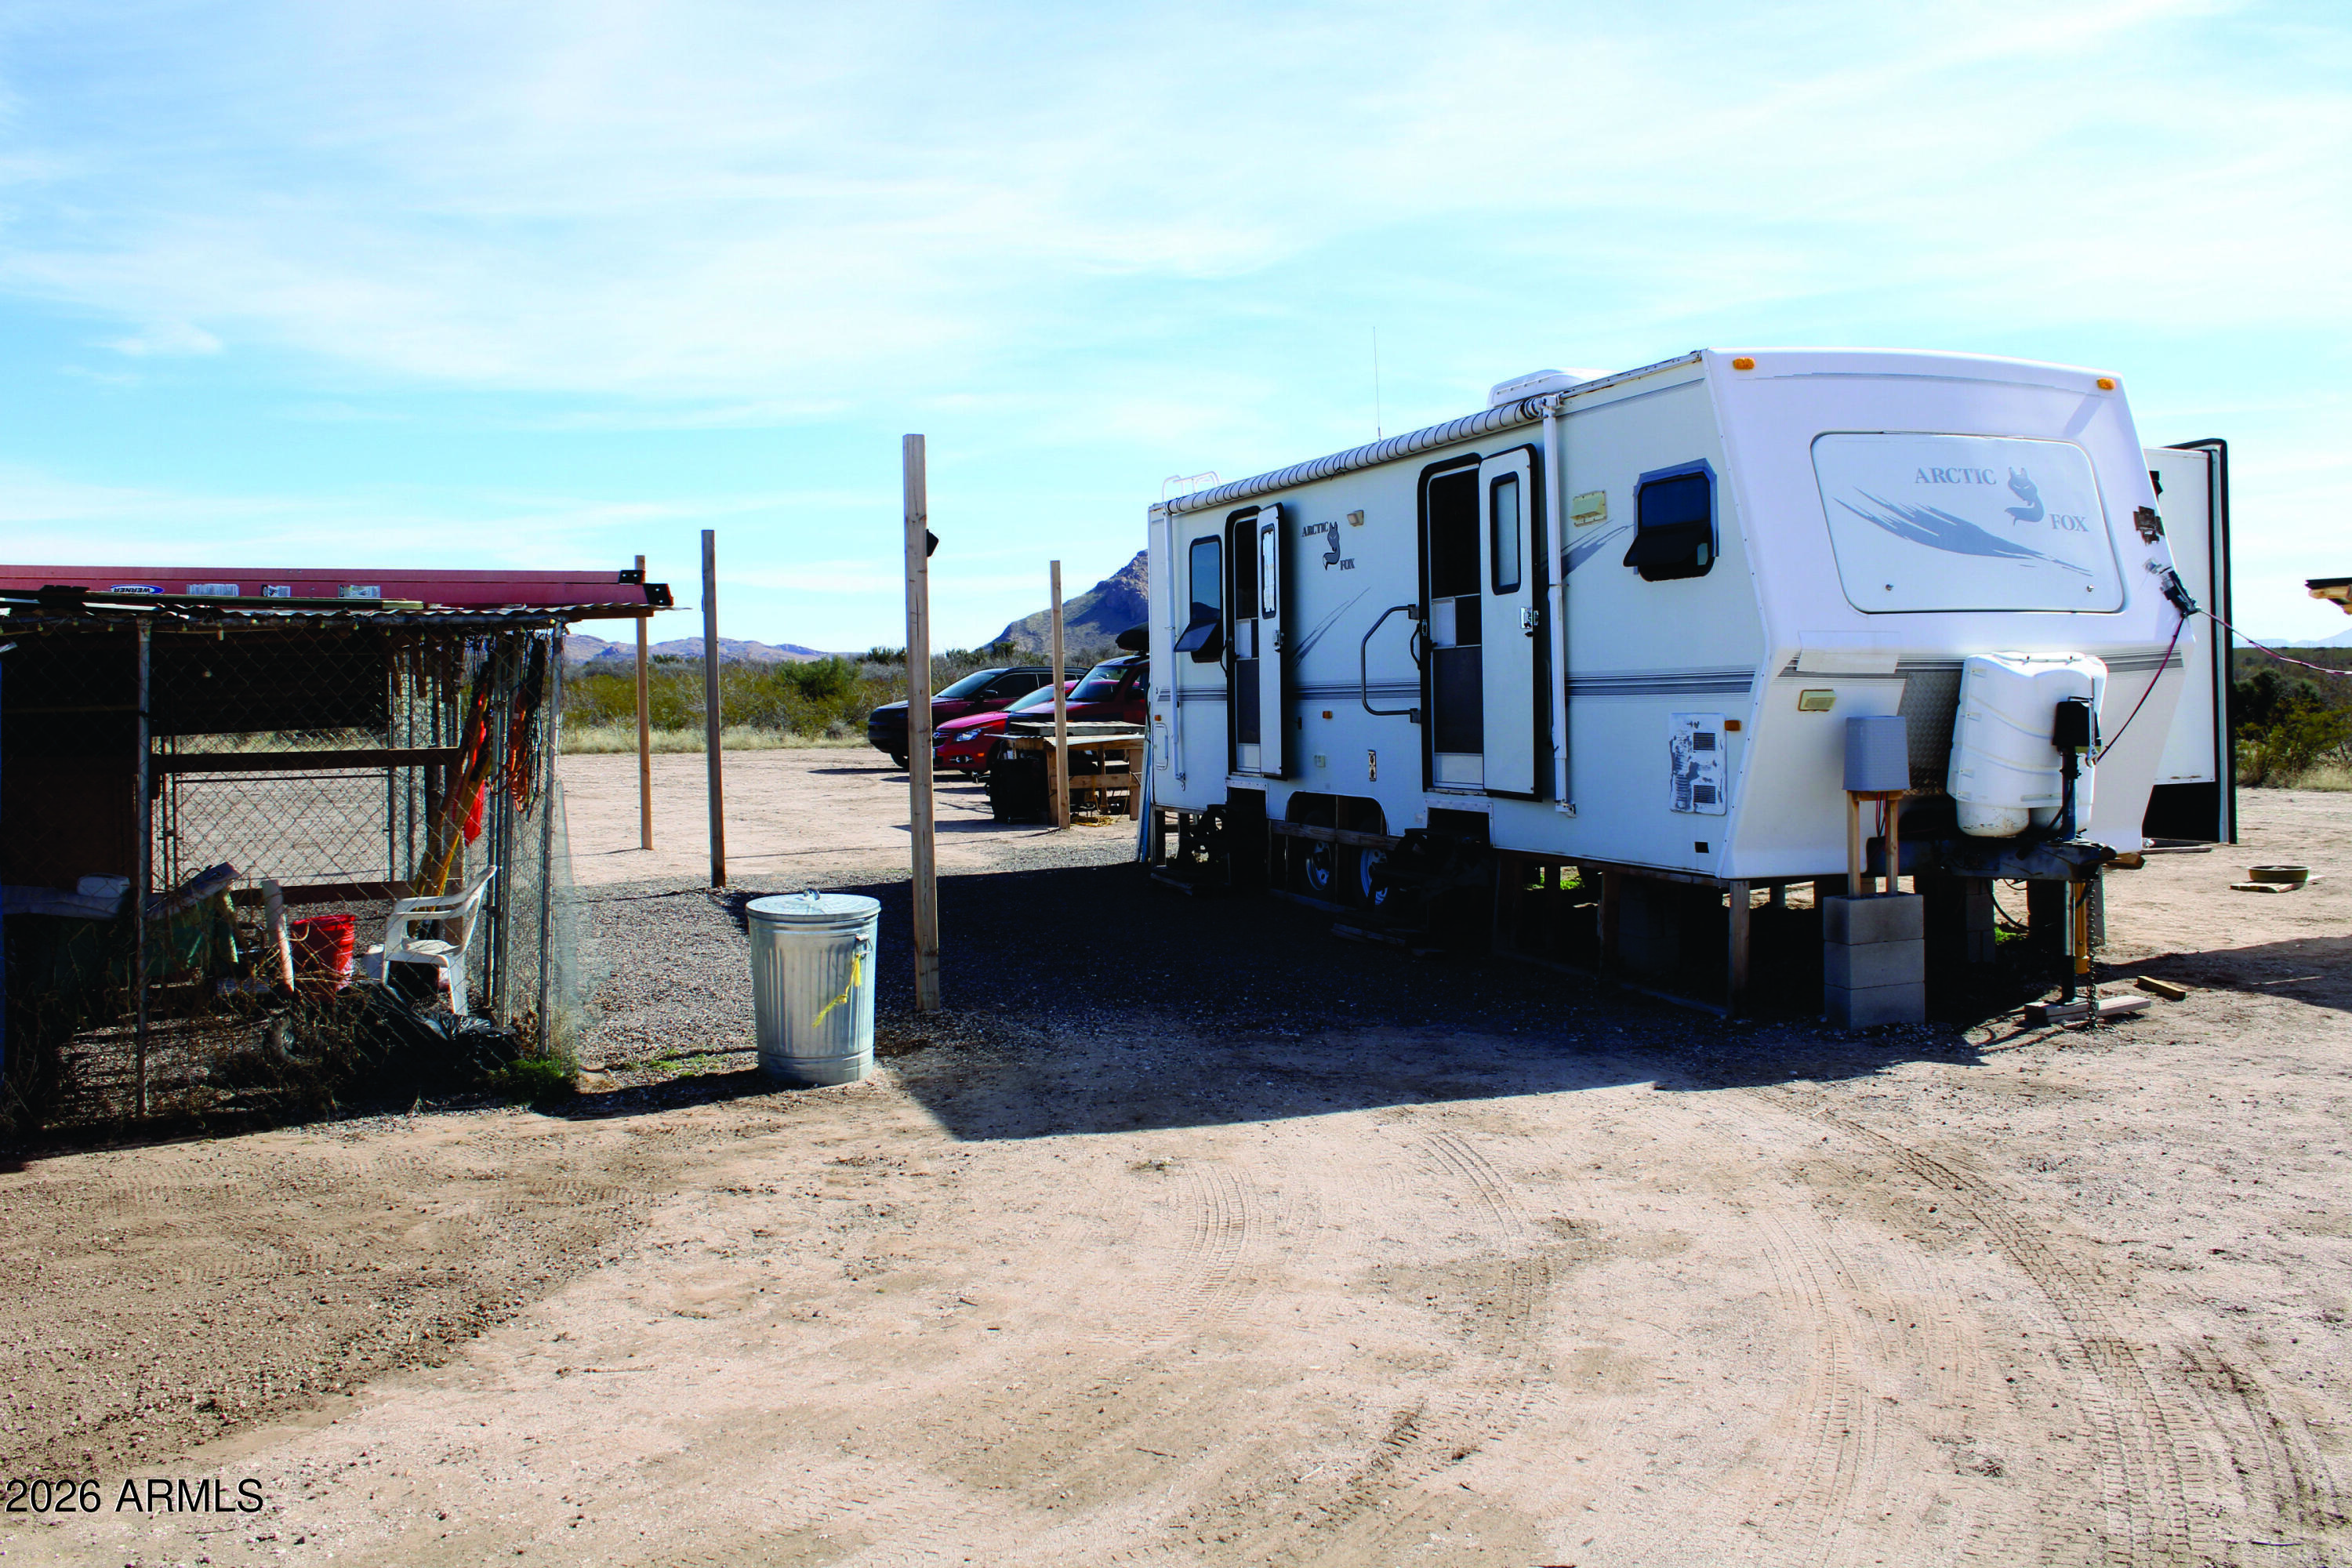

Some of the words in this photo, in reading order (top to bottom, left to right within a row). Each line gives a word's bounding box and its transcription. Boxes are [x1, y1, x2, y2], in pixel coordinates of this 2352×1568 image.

[1915, 467, 1997, 485] ARCTIC
[1301, 521, 1328, 537] ARCTIC
[2049, 514, 2089, 532] FOX
[1340, 558, 1355, 571] FOX
